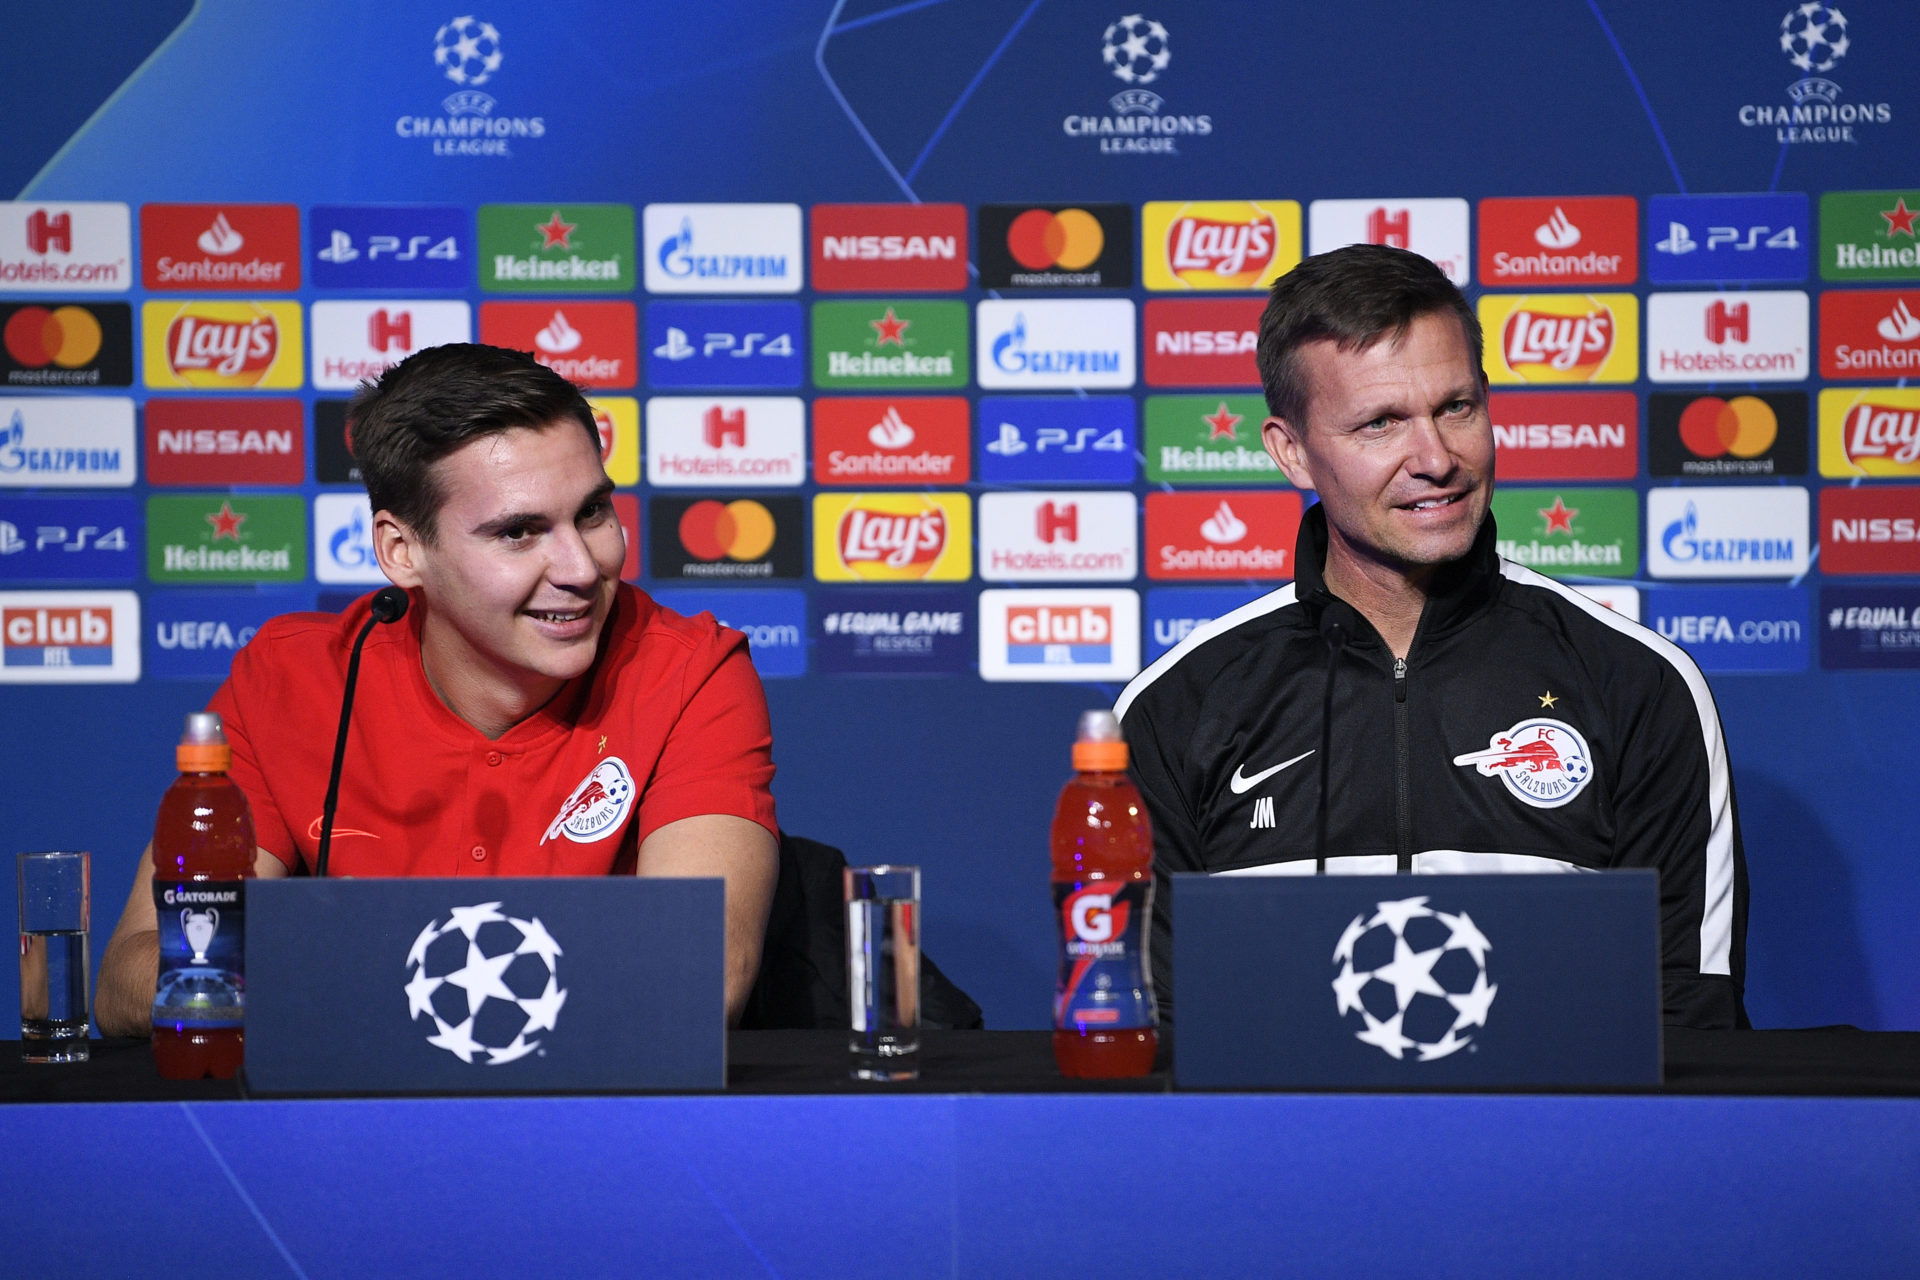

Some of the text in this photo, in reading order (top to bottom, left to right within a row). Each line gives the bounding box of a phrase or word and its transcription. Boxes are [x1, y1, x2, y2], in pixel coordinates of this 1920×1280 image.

[1789, 81, 1837, 101] UEFA
[396, 115, 545, 138] CHAMPIONS
[1063, 115, 1212, 136] CHAMPIONS
[1738, 103, 1892, 126] CHAMPIONS
[433, 138, 508, 156] LEAGUE
[1100, 137, 1175, 155] LEAGUE
[1777, 126, 1854, 143] LEAGUE
[368, 235, 459, 261] PS4
[823, 235, 956, 260] NISSAN
[1173, 219, 1272, 276] Lay's
[1707, 226, 1799, 250] PS4
[494, 255, 620, 281] Heineken
[695, 255, 787, 278] GAZPROM
[1494, 251, 1621, 277] Santander
[1836, 242, 1920, 269] Heine
[157, 257, 285, 282] Santander
[1011, 272, 1100, 286] mastercard
[174, 316, 272, 376] Lay's
[703, 332, 795, 357] PS4
[1156, 330, 1258, 355] NISSA
[1510, 311, 1608, 371] Lay's
[828, 351, 953, 377] Heineken
[1028, 350, 1120, 374] GAZPROM
[1659, 349, 1795, 371] Hotels.com
[1835, 344, 1920, 369] Santan
[8, 368, 100, 385] mastercard
[157, 429, 292, 455] NISSAN
[1036, 427, 1126, 452] PS4
[1494, 423, 1626, 448] NISSAN
[1850, 403, 1920, 465] Lay
[28, 448, 121, 472] GAZPROM
[659, 453, 792, 476] Hotels.com
[829, 450, 954, 475] Santander
[1682, 458, 1774, 474] mastercard
[36, 526, 129, 551] PS4
[845, 508, 942, 568] Lay's
[1832, 518, 1920, 543] NISS
[163, 545, 290, 572] Heineken
[992, 549, 1124, 571] Hotels.com
[1160, 545, 1287, 571] Santander
[1496, 540, 1622, 566] Heineken
[1701, 538, 1794, 561] GAZPROM
[684, 561, 773, 576] mastercard
[8, 608, 108, 644] club
[1009, 606, 1108, 642] club
[1656, 616, 1800, 643] UEFA.com
[1538, 728, 1555, 741] FC
[1515, 770, 1568, 795] SALZBURG
[570, 806, 614, 831] SALZBURG
[1250, 796, 1276, 829] JM
[176, 891, 237, 902] GATORADE
[1071, 893, 1112, 941] G
